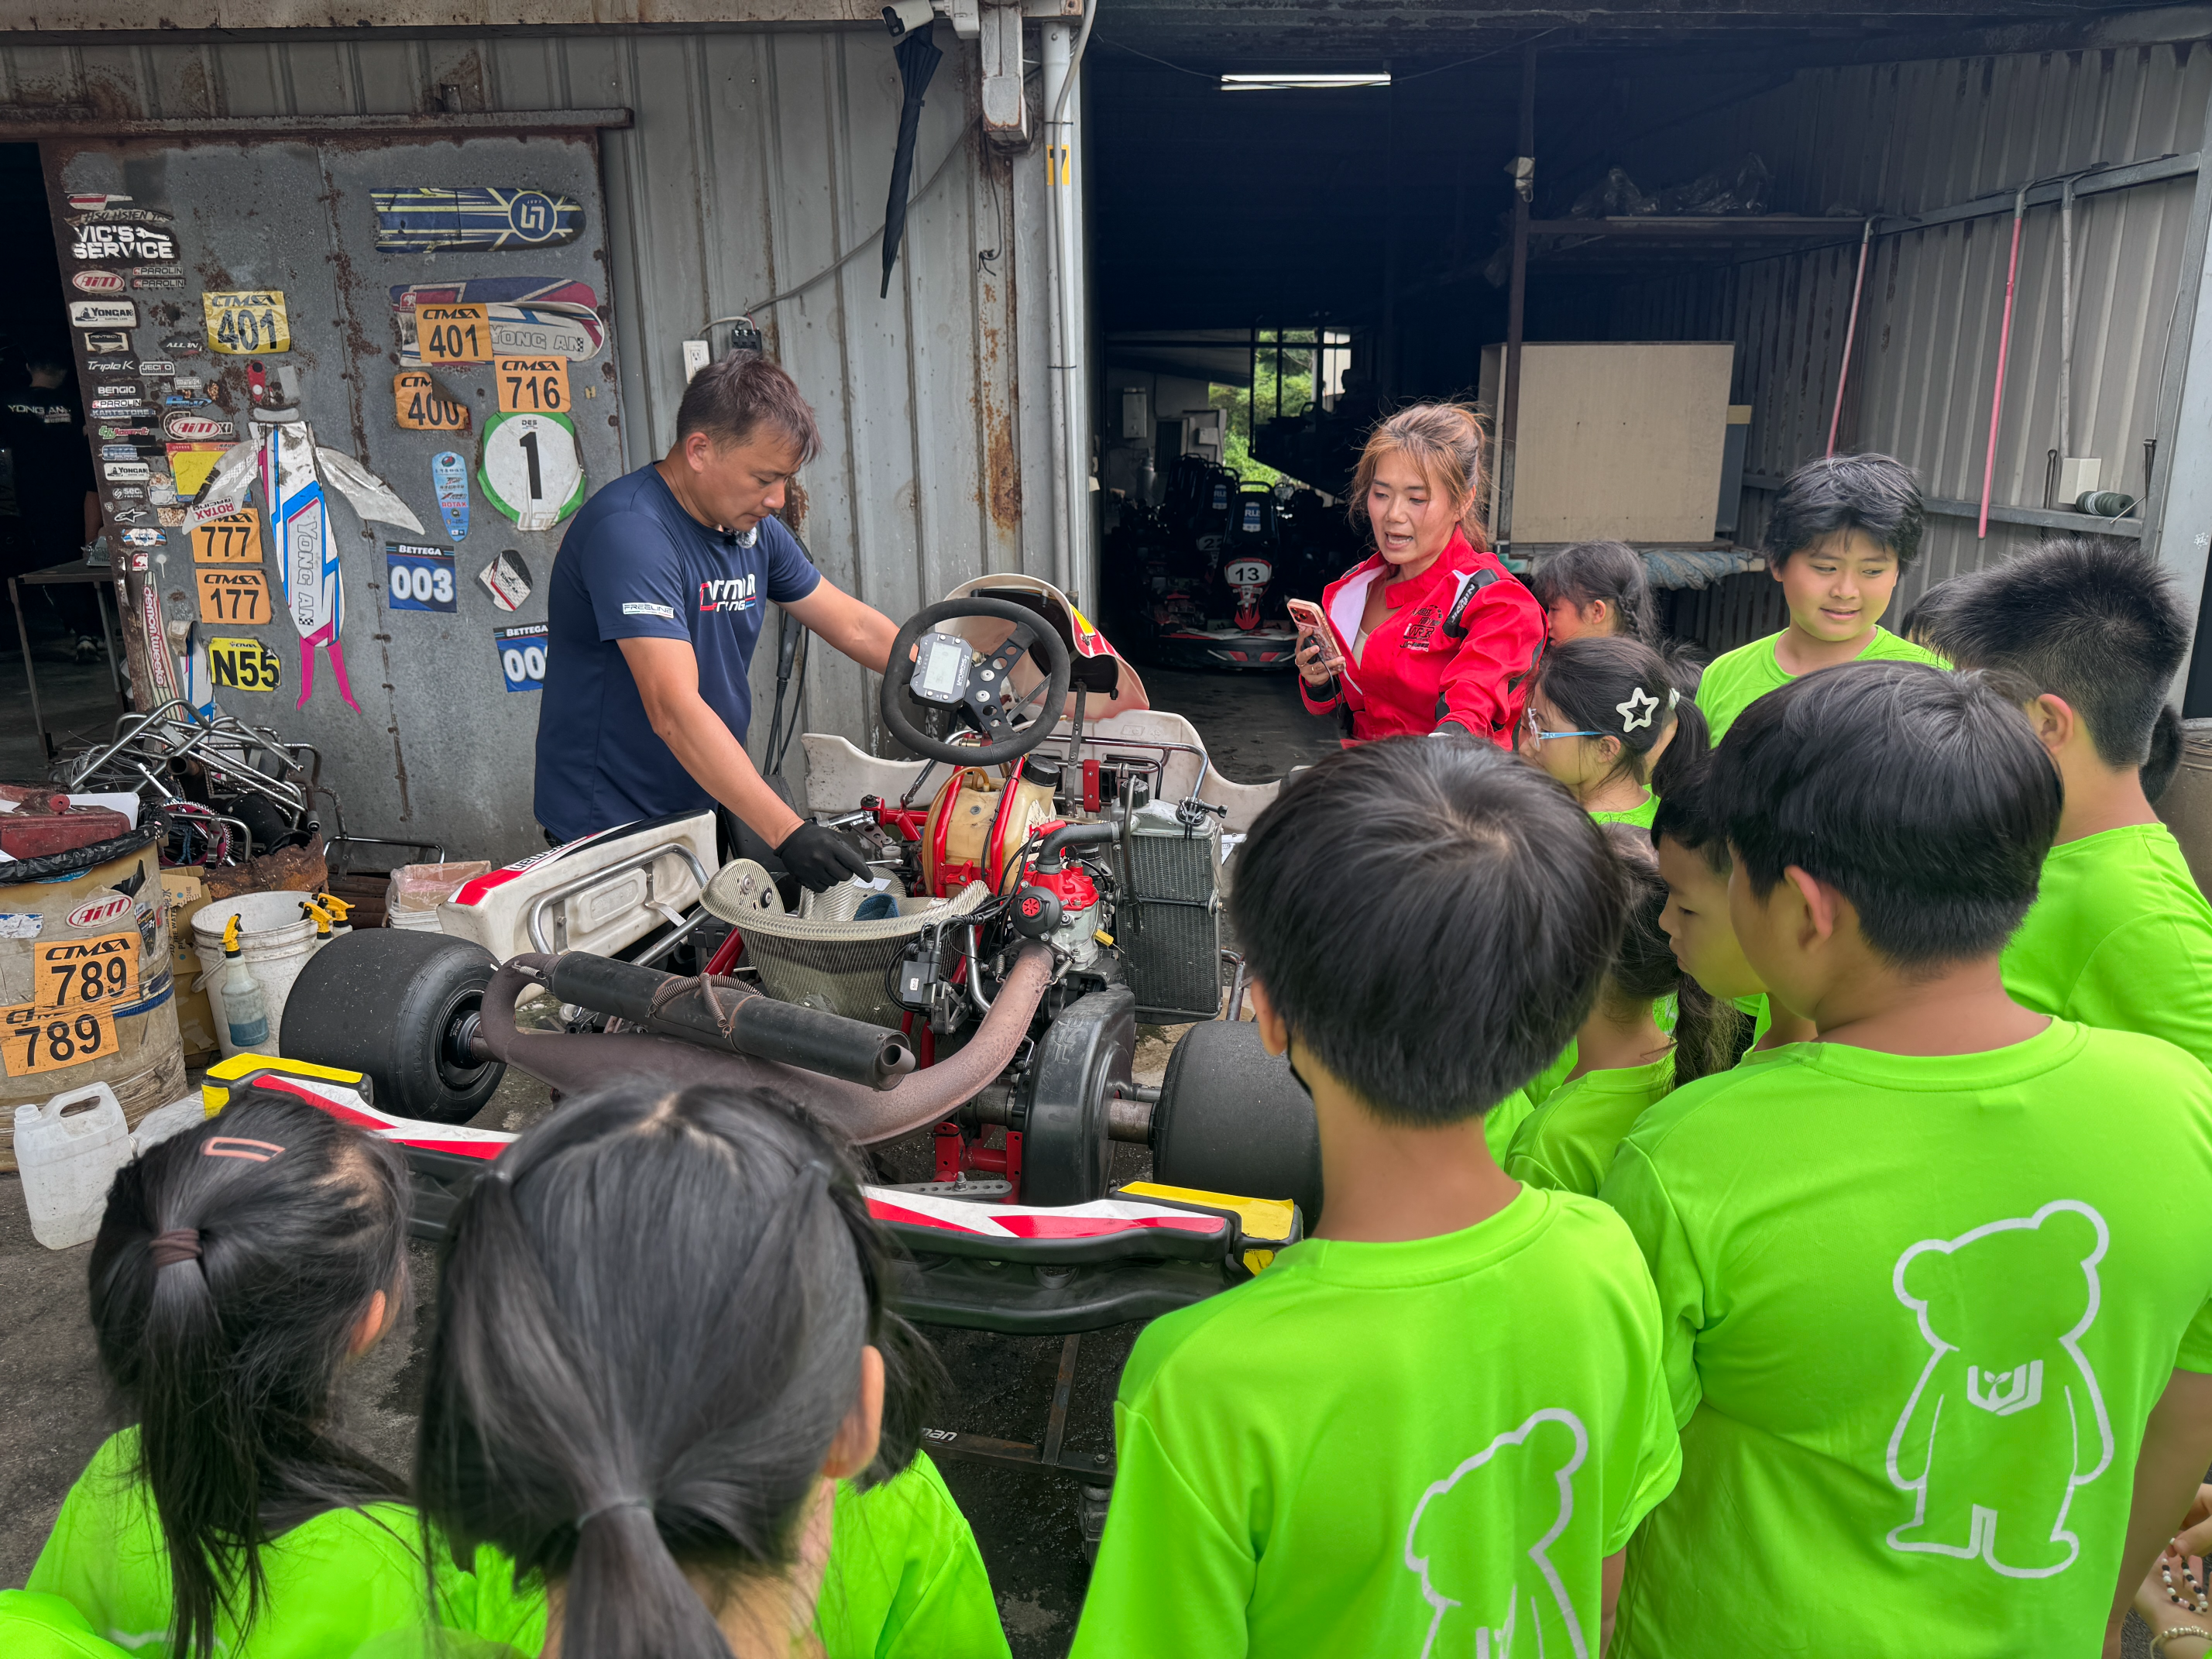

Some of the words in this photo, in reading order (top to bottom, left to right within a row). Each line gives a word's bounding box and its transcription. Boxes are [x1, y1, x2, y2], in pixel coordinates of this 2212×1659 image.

[74, 225, 135, 242] VIC'S
[72, 242, 175, 259] SERVICE
[422, 308, 481, 320] CTMSA
[217, 309, 278, 351] 401
[429, 325, 479, 359] 401
[122, 361, 135, 370] K
[502, 361, 561, 371] CTMSA
[507, 376, 561, 409] 716
[520, 431, 542, 500] 1
[197, 503, 235, 520] ROTAX
[201, 527, 251, 557] 777
[297, 521, 317, 586] YONG
[399, 544, 442, 555] BETTEGA
[204, 575, 262, 585] CTMSA
[391, 565, 454, 603] 003
[1235, 567, 1260, 581] 13
[143, 586, 157, 634] demon
[211, 589, 259, 620] 177
[624, 604, 672, 614] FREELINE
[507, 624, 548, 637] BETTEGA
[149, 634, 165, 686] tweeks
[212, 650, 280, 687] N55
[504, 645, 548, 682] 00
[45, 939, 131, 960] CTMSA
[51, 957, 127, 1005] 789
[15, 1014, 101, 1067] 789
